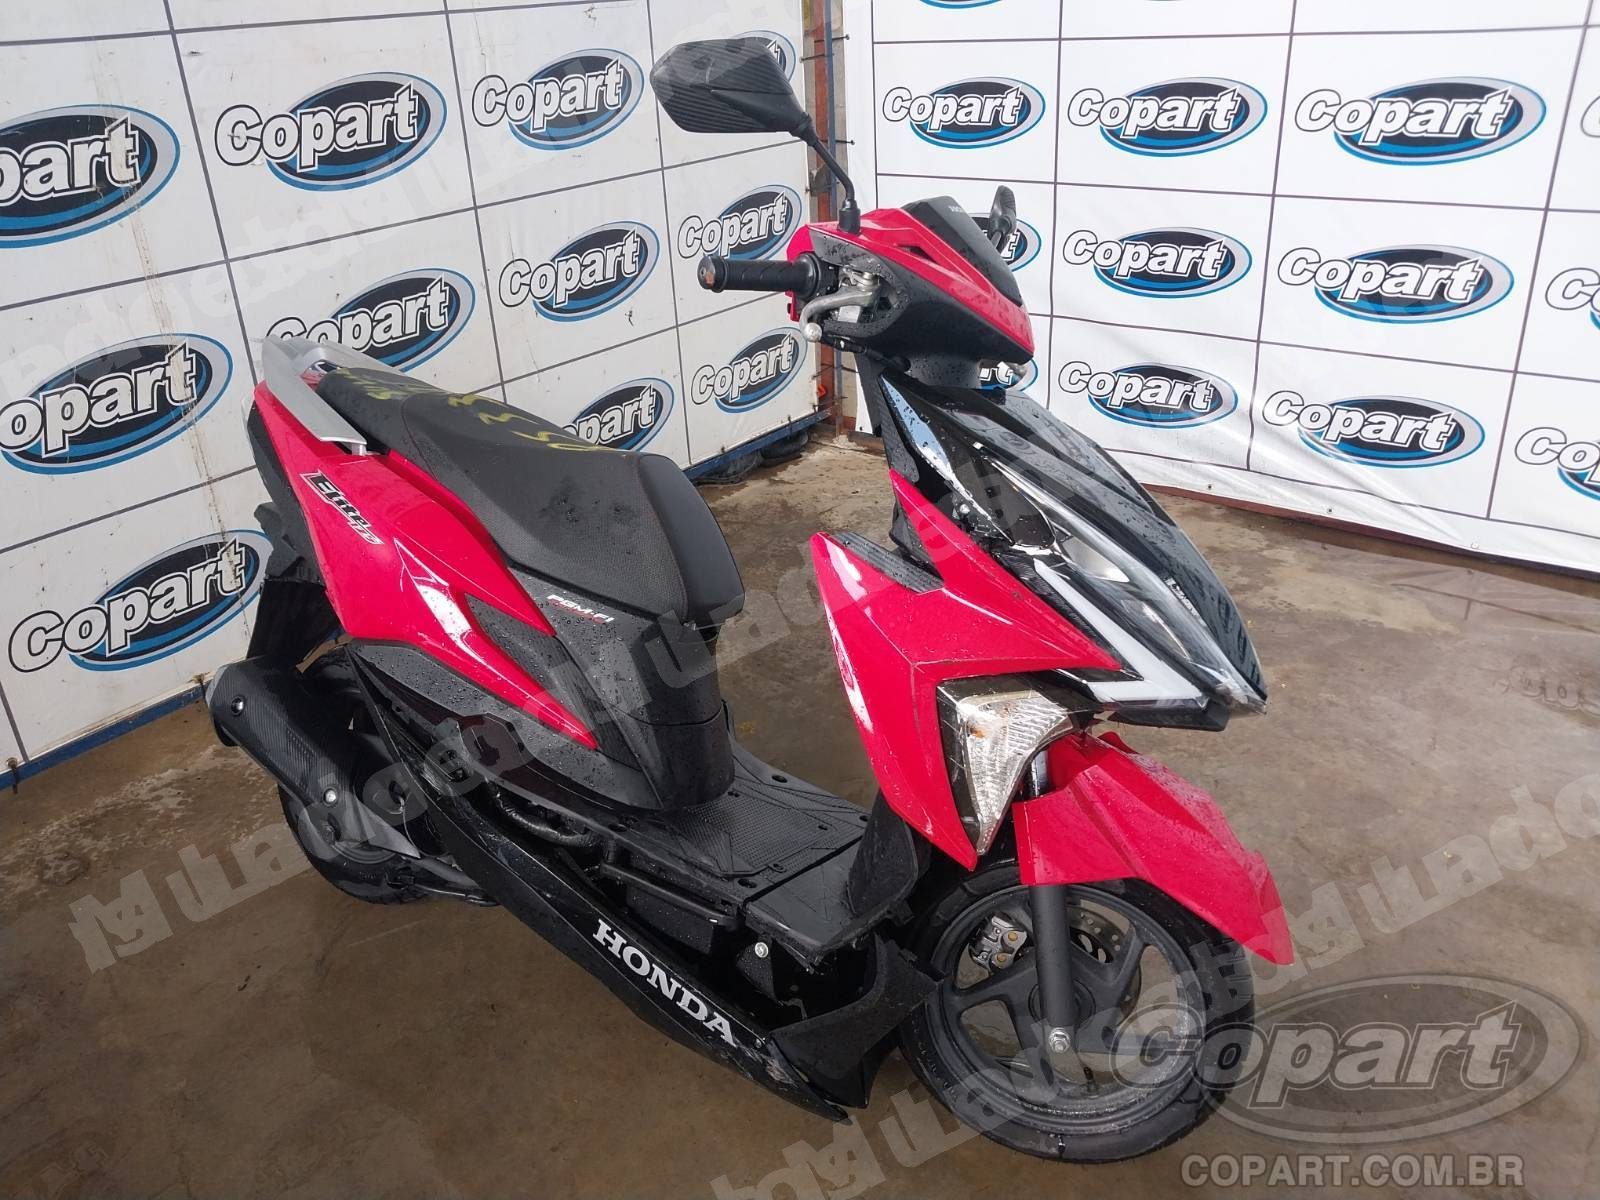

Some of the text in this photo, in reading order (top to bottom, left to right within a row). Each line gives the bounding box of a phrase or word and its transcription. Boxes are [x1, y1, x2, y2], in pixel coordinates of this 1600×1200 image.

[472, 58, 625, 133] Copart
[882, 83, 1025, 132] Copart
[1067, 83, 1241, 139] Copart
[1295, 87, 1514, 145] Copart
[214, 82, 420, 172] Copart
[677, 190, 788, 259] Copart
[1062, 229, 1228, 278] Copart
[499, 229, 643, 308] Copart
[1277, 247, 1483, 303] Copart
[691, 333, 795, 405] Copart
[1058, 361, 1214, 412] Copart
[562, 384, 656, 445] part
[1261, 390, 1454, 451] Copart
[1514, 427, 1600, 483] Co
[8, 535, 248, 673] Copart
[592, 918, 737, 1048] HONDA
